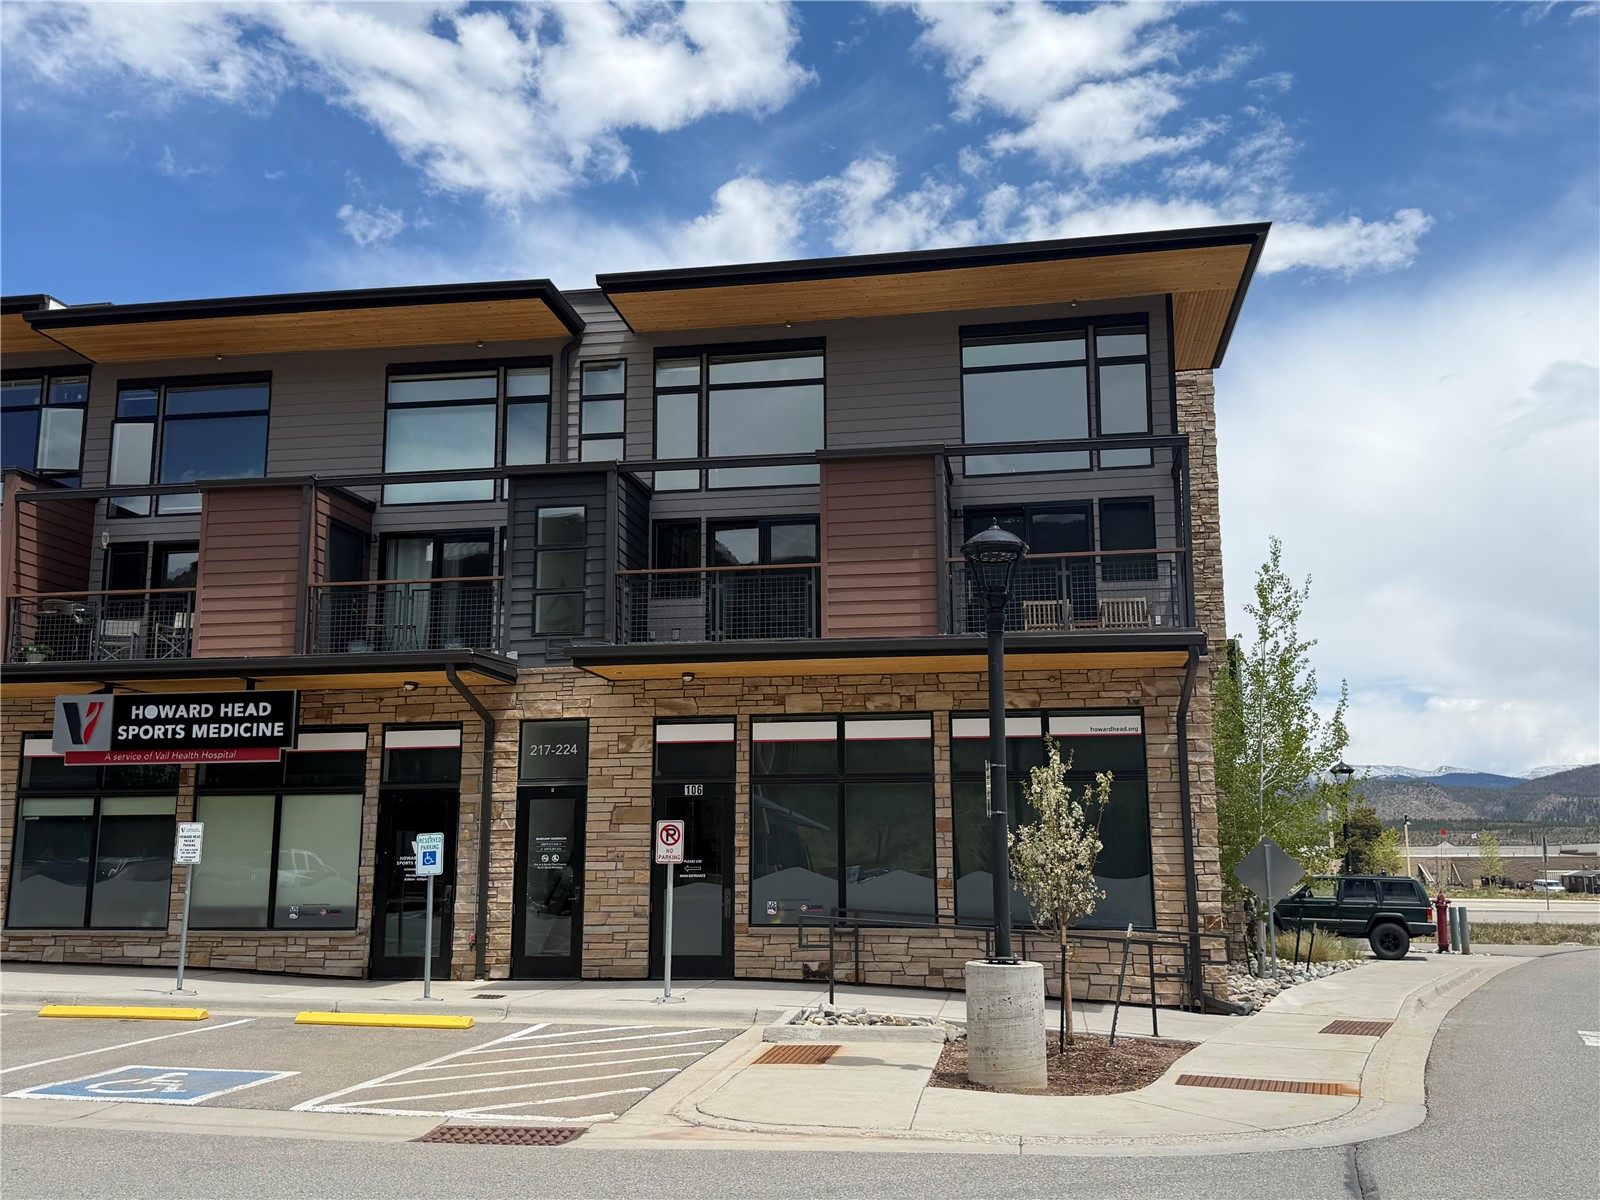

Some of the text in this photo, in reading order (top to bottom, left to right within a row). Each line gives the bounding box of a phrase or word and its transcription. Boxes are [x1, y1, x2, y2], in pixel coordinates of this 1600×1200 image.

[131, 702, 272, 720] HOWARD HEAD
[117, 722, 284, 740] SPORTS MEDICINE
[104, 750, 237, 761] A service of Vail Health Hospital
[530, 743, 578, 756] 217-224
[684, 784, 703, 796] 106
[419, 836, 442, 844] RESERVED
